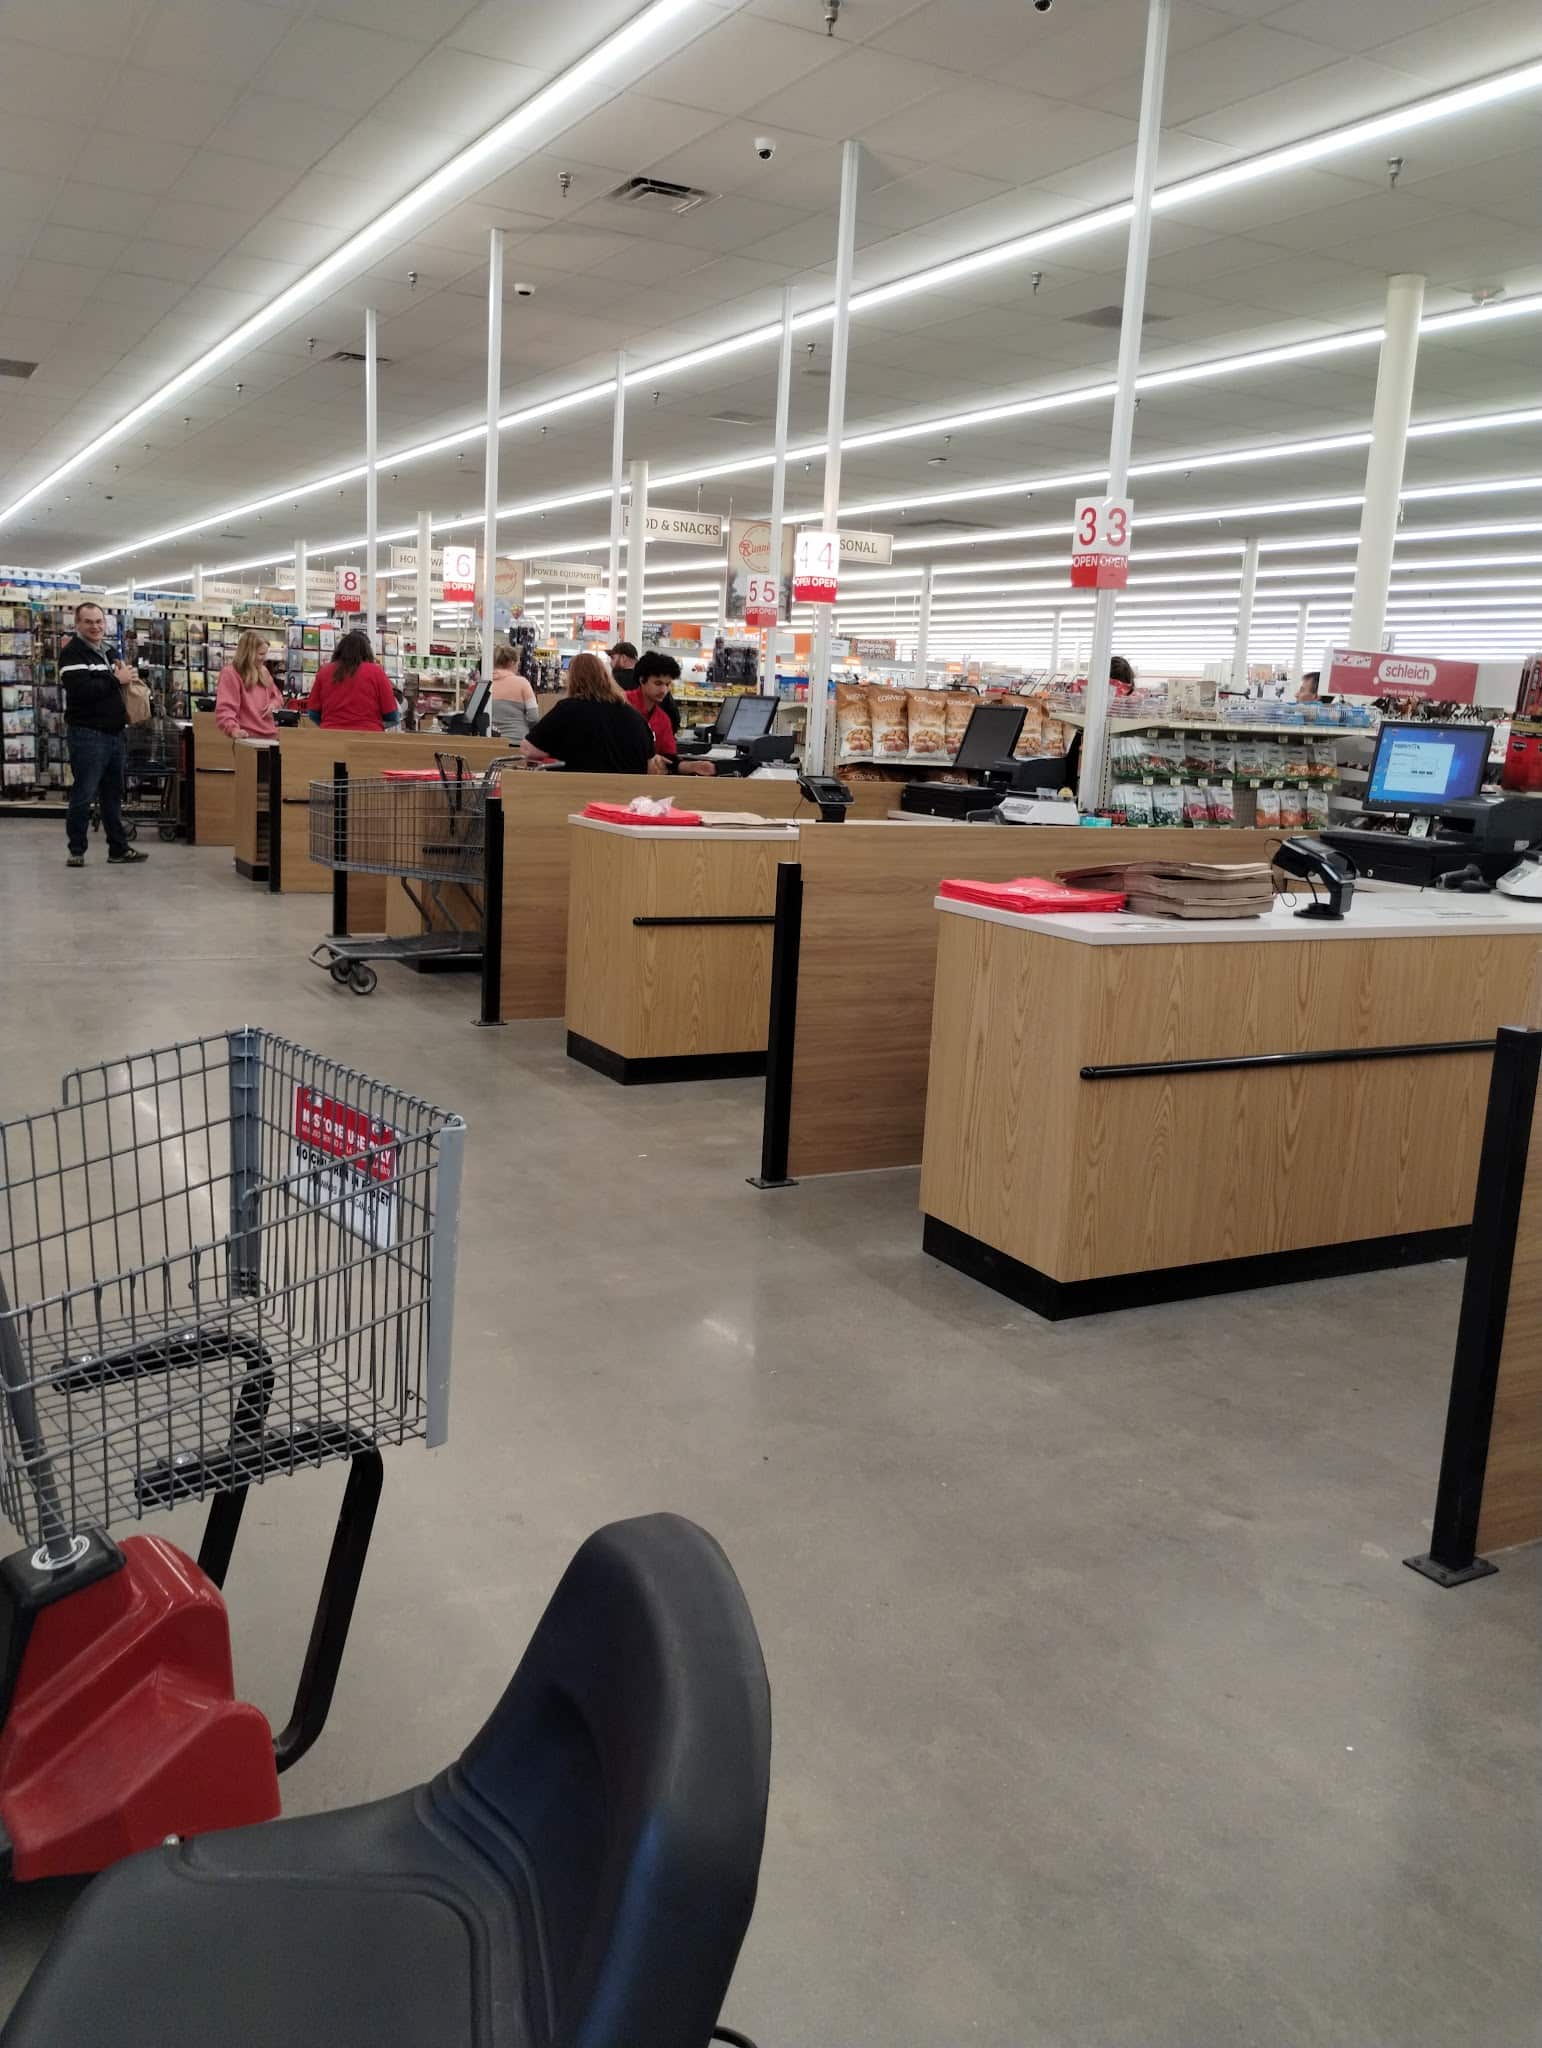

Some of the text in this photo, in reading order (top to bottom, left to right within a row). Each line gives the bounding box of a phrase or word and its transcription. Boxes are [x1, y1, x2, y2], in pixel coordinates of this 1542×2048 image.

[661, 520, 670, 530] &
[673, 521, 719, 536] SNACKS
[1079, 507, 1097, 546] 3
[1106, 507, 1127, 547] 3
[839, 539, 878, 553] SONAL
[818, 542, 834, 570] 4
[1073, 555, 1098, 568] OPEN
[1100, 556, 1128, 569] OPEN
[456, 554, 471, 577] 6
[344, 571, 357, 591] 8
[533, 567, 601, 581] POWER EQUIPMENT
[451, 583, 474, 592] OPEN
[750, 580, 758, 602] 5
[763, 580, 775, 602] 5
[812, 578, 837, 588] OPEN
[758, 607, 776, 615] OPEN
[1385, 664, 1430, 681] schleich
